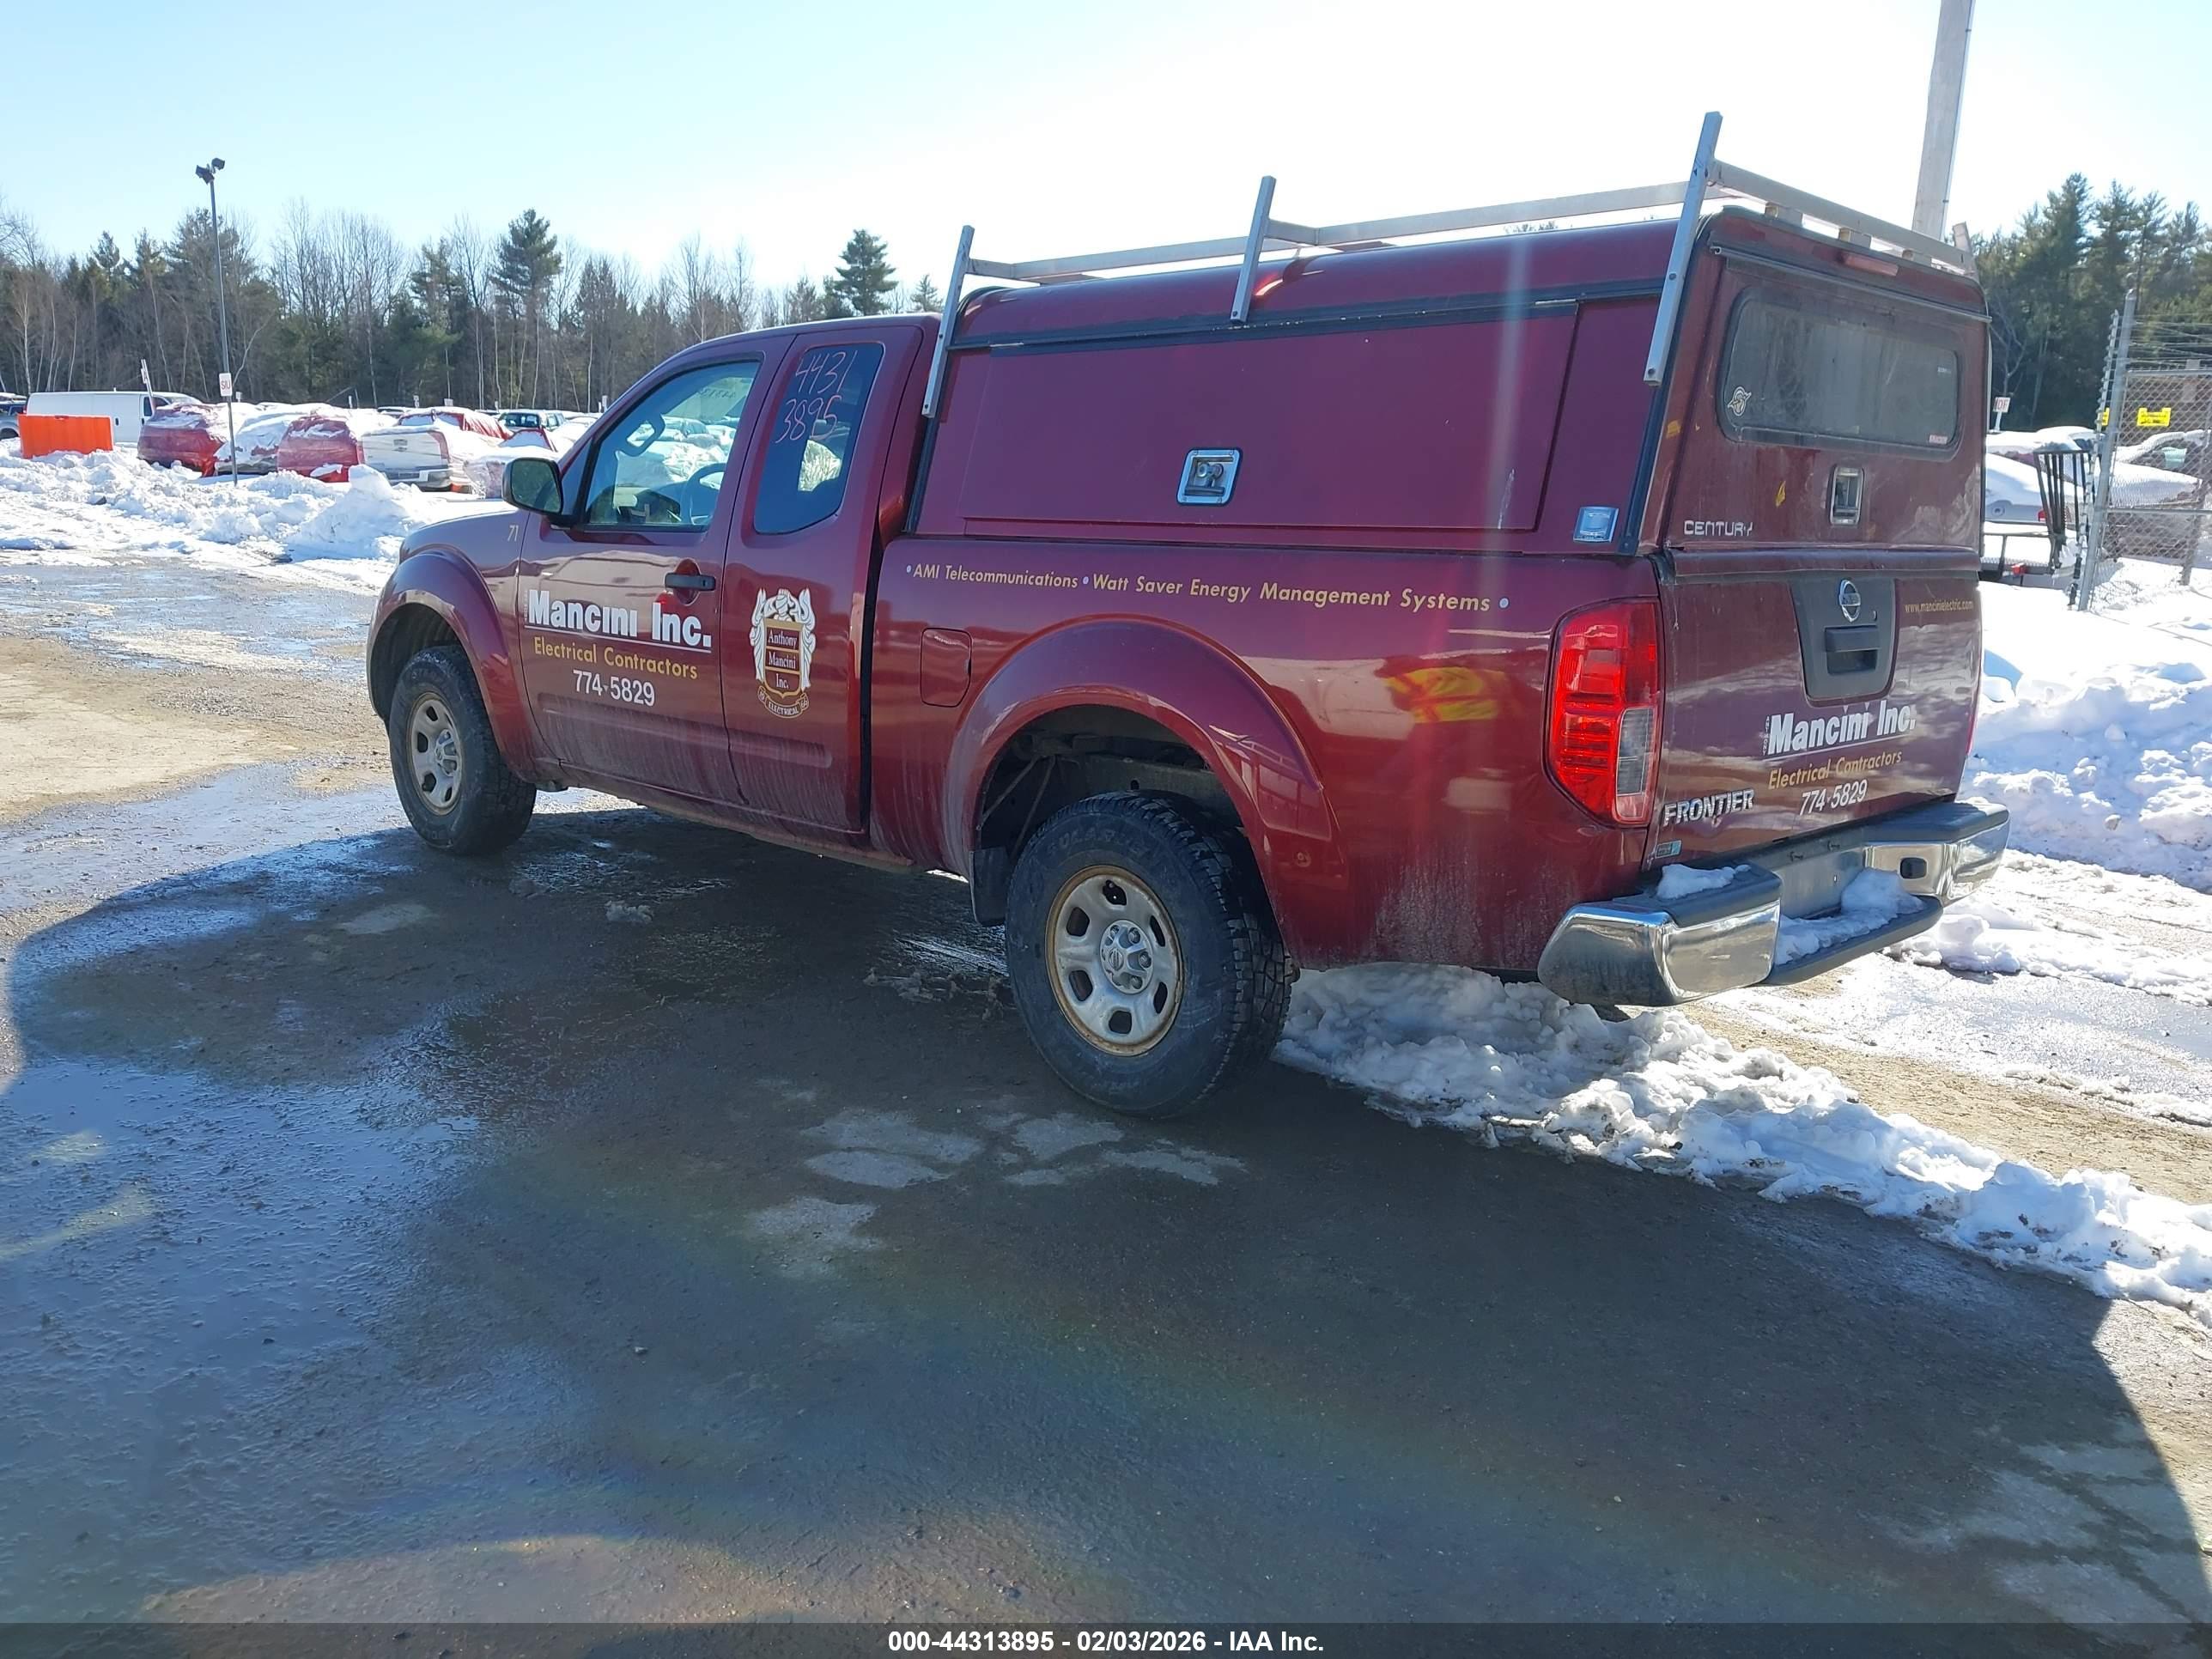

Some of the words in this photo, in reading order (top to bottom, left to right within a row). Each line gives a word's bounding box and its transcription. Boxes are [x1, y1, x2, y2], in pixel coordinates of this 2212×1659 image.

[795, 350, 858, 394] 4431
[775, 395, 842, 443] 3895
[507, 525, 519, 542] 71
[1684, 520, 1753, 537] CENTURY
[914, 563, 939, 579] AMI
[945, 564, 1079, 588] Telecommunications
[1093, 574, 1129, 592] Watt
[1135, 575, 1182, 595] Saver
[1189, 579, 1251, 603] Energy
[1260, 581, 1391, 609] Management
[1400, 588, 1491, 613] Systems
[528, 589, 638, 637] Mancini
[652, 602, 712, 648] Inc.
[534, 636, 598, 664] Electrical
[604, 647, 699, 680] Contractors
[769, 629, 798, 650] Anthony
[769, 652, 797, 670] Mancini
[776, 673, 789, 689] Inc.
[769, 701, 799, 715] ELECTRICAL
[1767, 702, 1870, 756] Mancini
[1876, 700, 1917, 736] Inc.
[1768, 758, 1831, 790] Electrical
[1835, 750, 1902, 777] Contractors
[1662, 789, 1754, 827] FRONTIER
